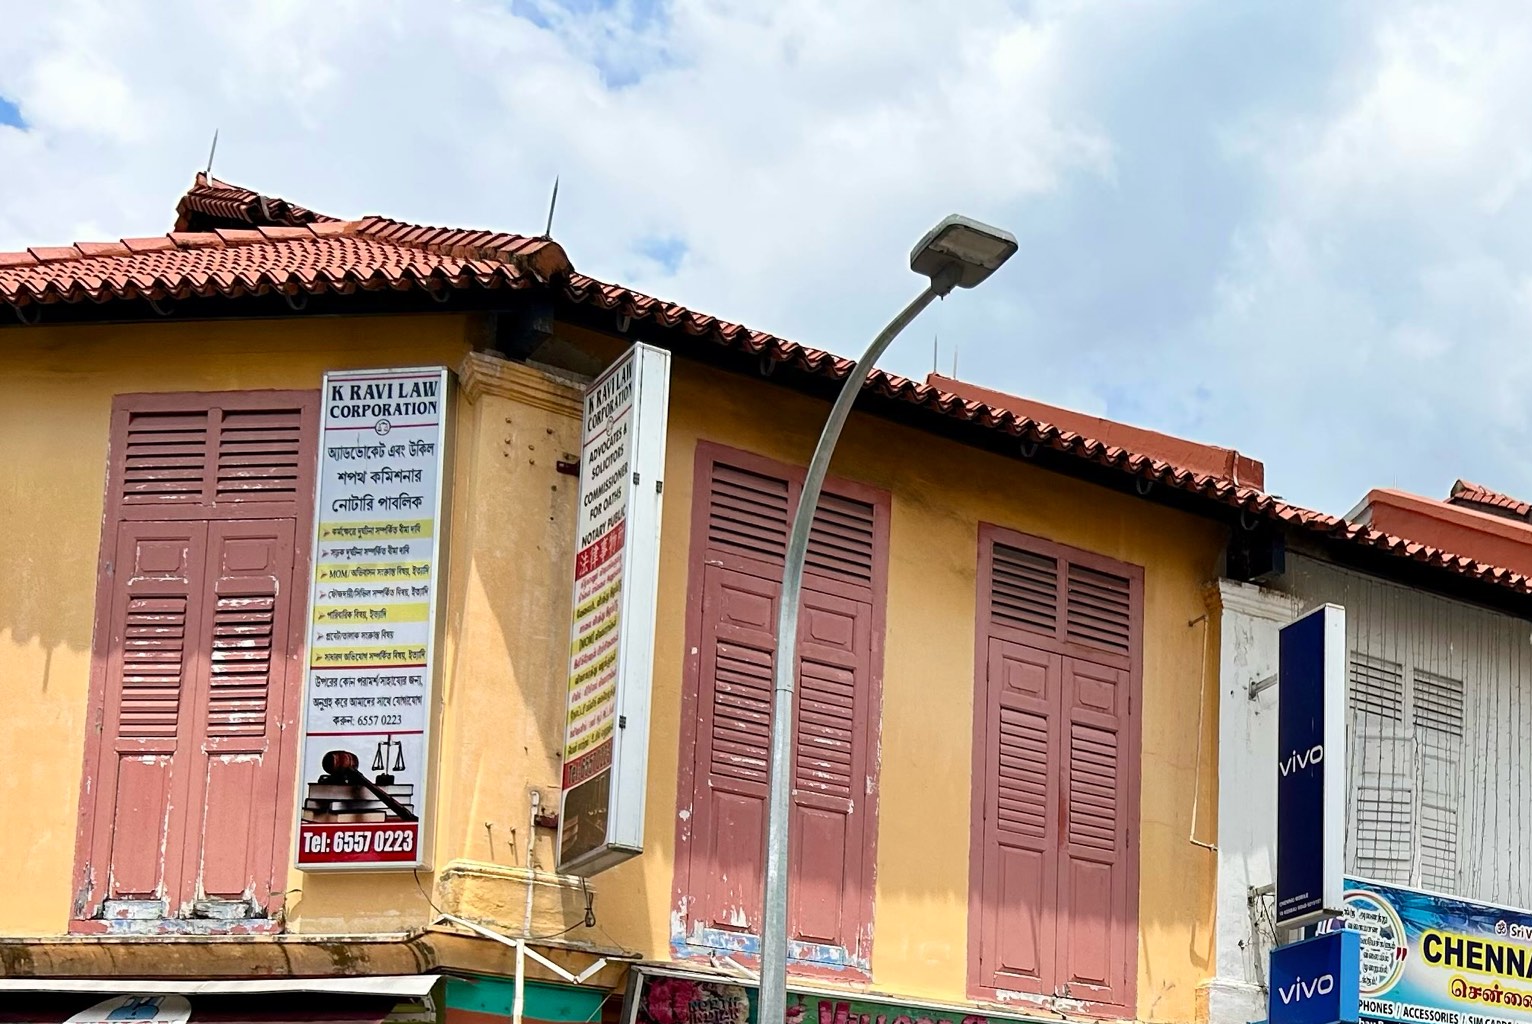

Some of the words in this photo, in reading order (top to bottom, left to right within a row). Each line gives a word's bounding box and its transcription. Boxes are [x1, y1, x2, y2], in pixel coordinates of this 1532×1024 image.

[332, 385, 344, 401] K
[350, 383, 393, 400] RAVI
[398, 381, 438, 398] LAW
[596, 381, 616, 409] RAVI
[330, 401, 437, 418] CORPORATION
[388, 444, 405, 458] এবং
[409, 439, 435, 457] উকিল
[588, 429, 622, 464] ADVOCATES
[591, 443, 624, 480] SOLICITORS
[337, 470, 367, 485] শপথ
[370, 466, 423, 484] কমিশনার
[584, 462, 628, 507] COMMISSIONER
[332, 494, 375, 512] নোটারি
[378, 492, 423, 511] পাবলিক
[590, 502, 602, 521] FOR
[603, 486, 622, 510] OATHS
[581, 522, 606, 548] NOTARY
[607, 504, 626, 531] PUBLIC
[357, 715, 379, 725] 6557
[380, 715, 402, 725] 0223
[1279, 744, 1324, 777] vivo
[303, 832, 331, 852] Tel:
[333, 831, 372, 852] 6557
[374, 830, 413, 852] 0223
[1512, 926, 1525, 938] Sri
[1279, 973, 1334, 1004] vivo
[1403, 1006, 1459, 1024] ACCESSORIES
